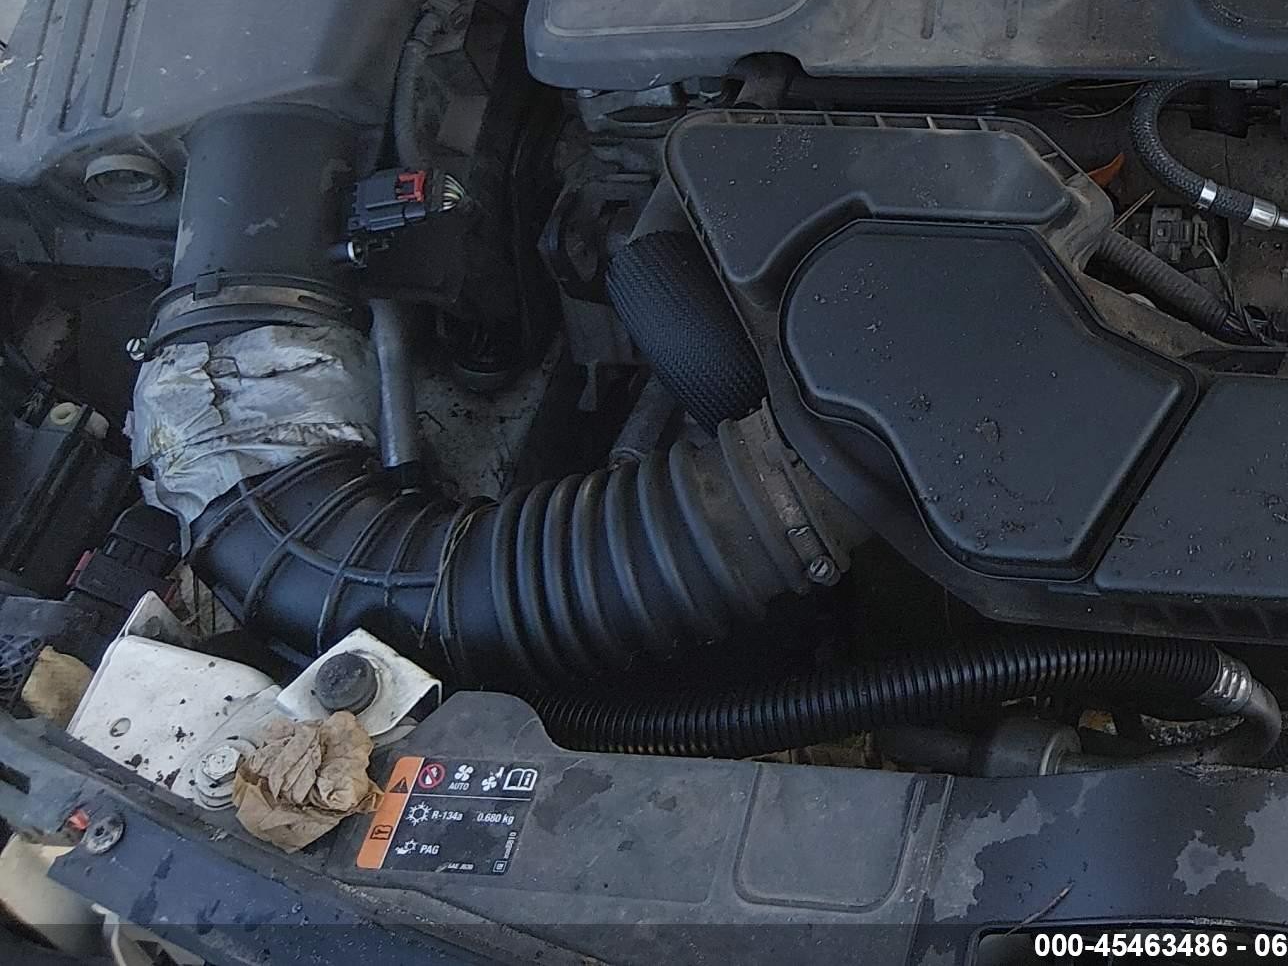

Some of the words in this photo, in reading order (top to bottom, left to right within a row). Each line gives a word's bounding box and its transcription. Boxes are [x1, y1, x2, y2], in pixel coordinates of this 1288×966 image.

[448, 782, 470, 790] AUTO
[431, 810, 463, 821] R-134a
[476, 813, 502, 823] 0.680
[502, 814, 515, 826] kg
[420, 844, 440, 855] PAG
